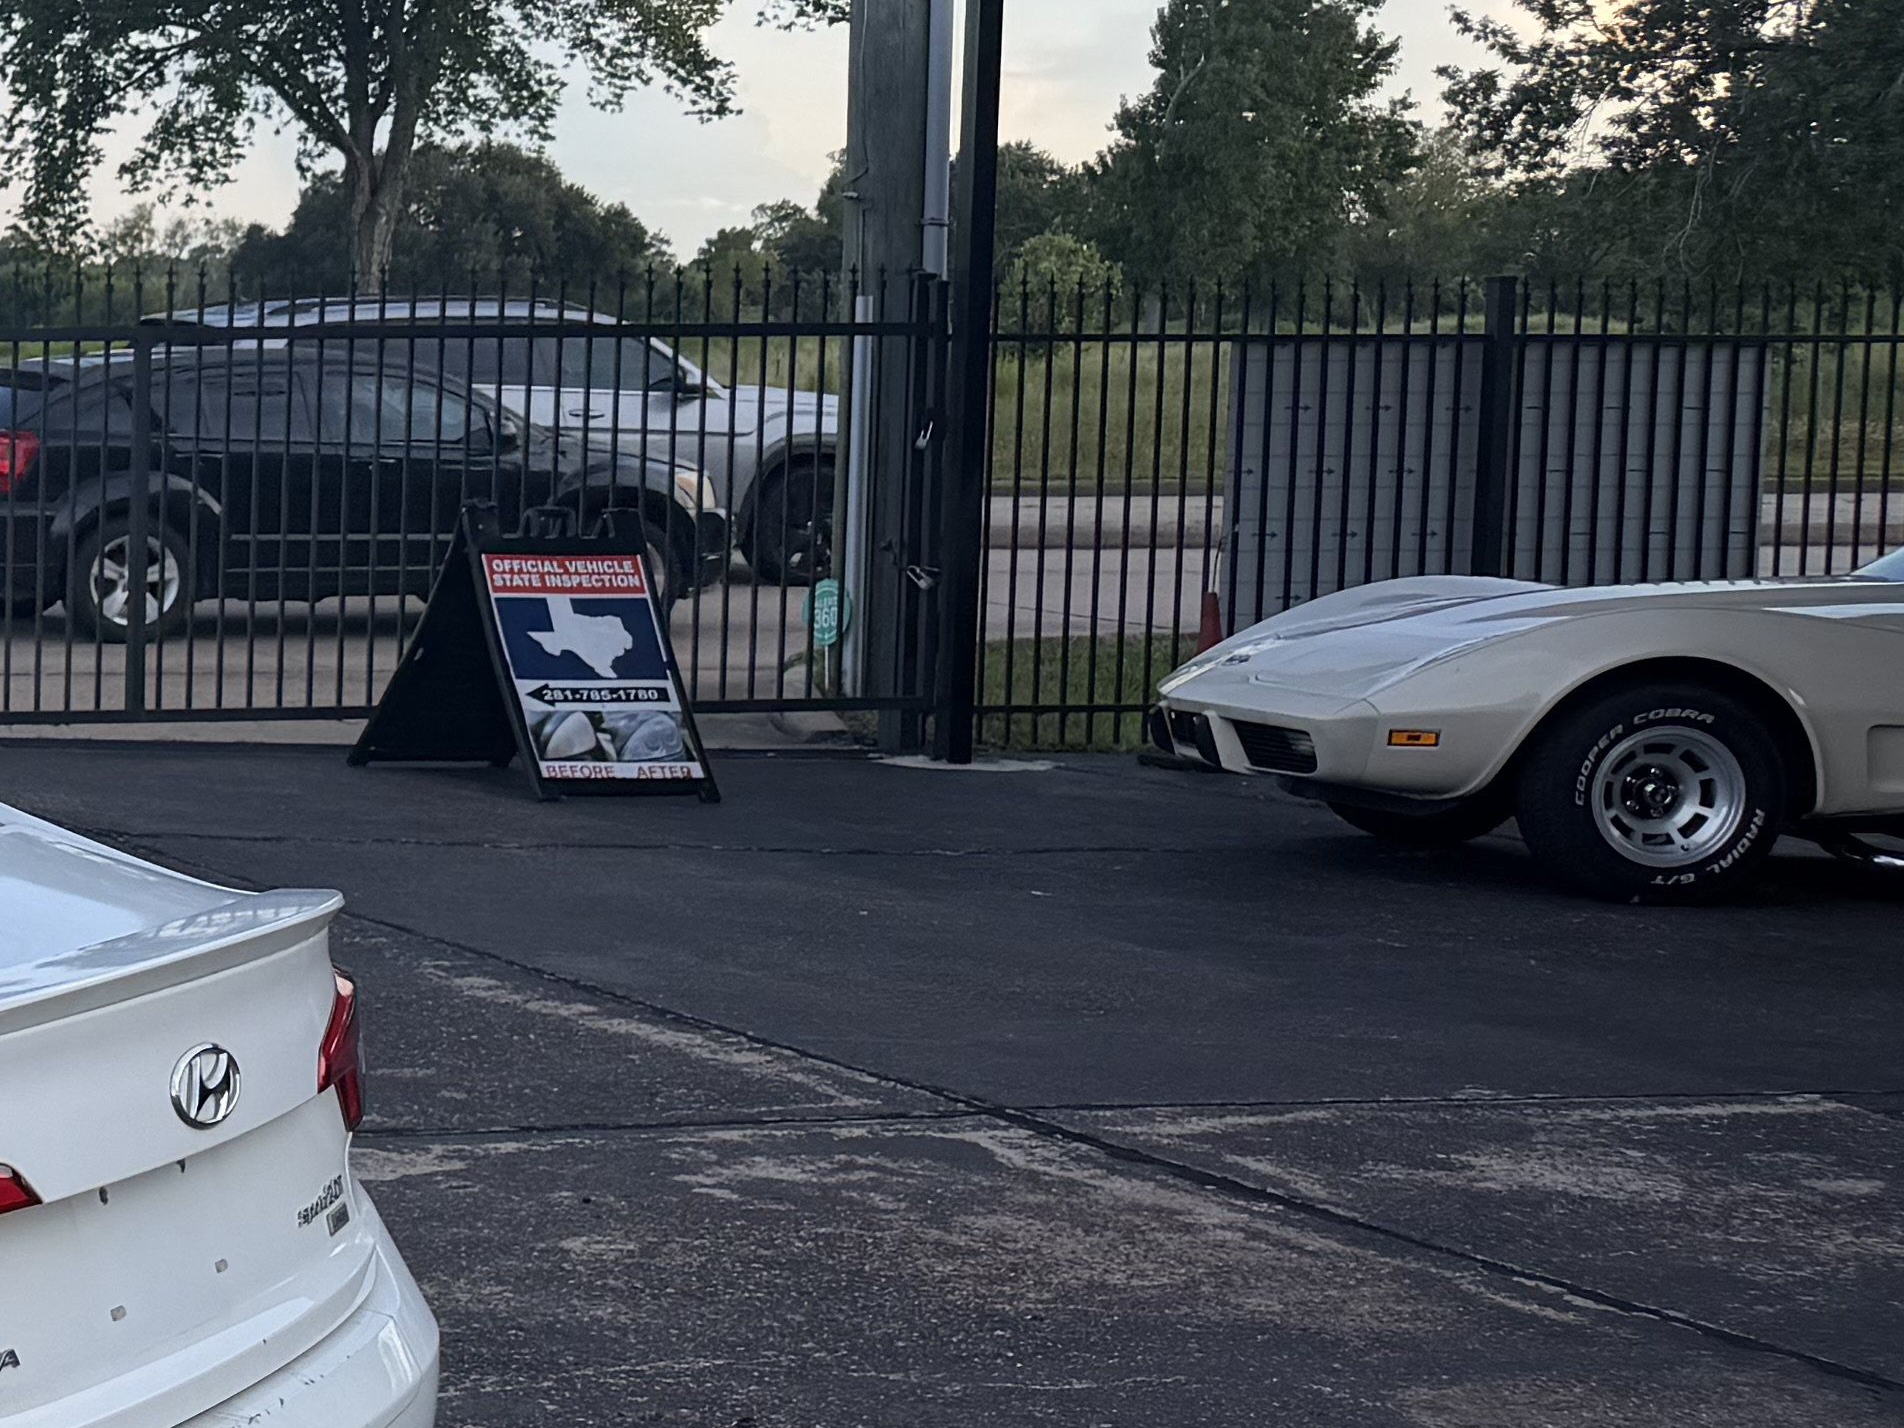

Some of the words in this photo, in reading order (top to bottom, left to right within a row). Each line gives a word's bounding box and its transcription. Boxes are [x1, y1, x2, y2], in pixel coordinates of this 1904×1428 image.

[492, 559, 563, 573] OFFICIAL
[566, 560, 634, 574] VEHICLE
[493, 574, 541, 587] STATE
[545, 574, 641, 588] INSPECTION
[542, 689, 659, 701] 281-785-1780
[1575, 724, 1624, 806] COOPER
[1633, 708, 1715, 724] COBRA
[545, 764, 615, 779] BEFORE
[1705, 808, 1766, 874] RADIAL
[1650, 873, 1696, 885] G/T
